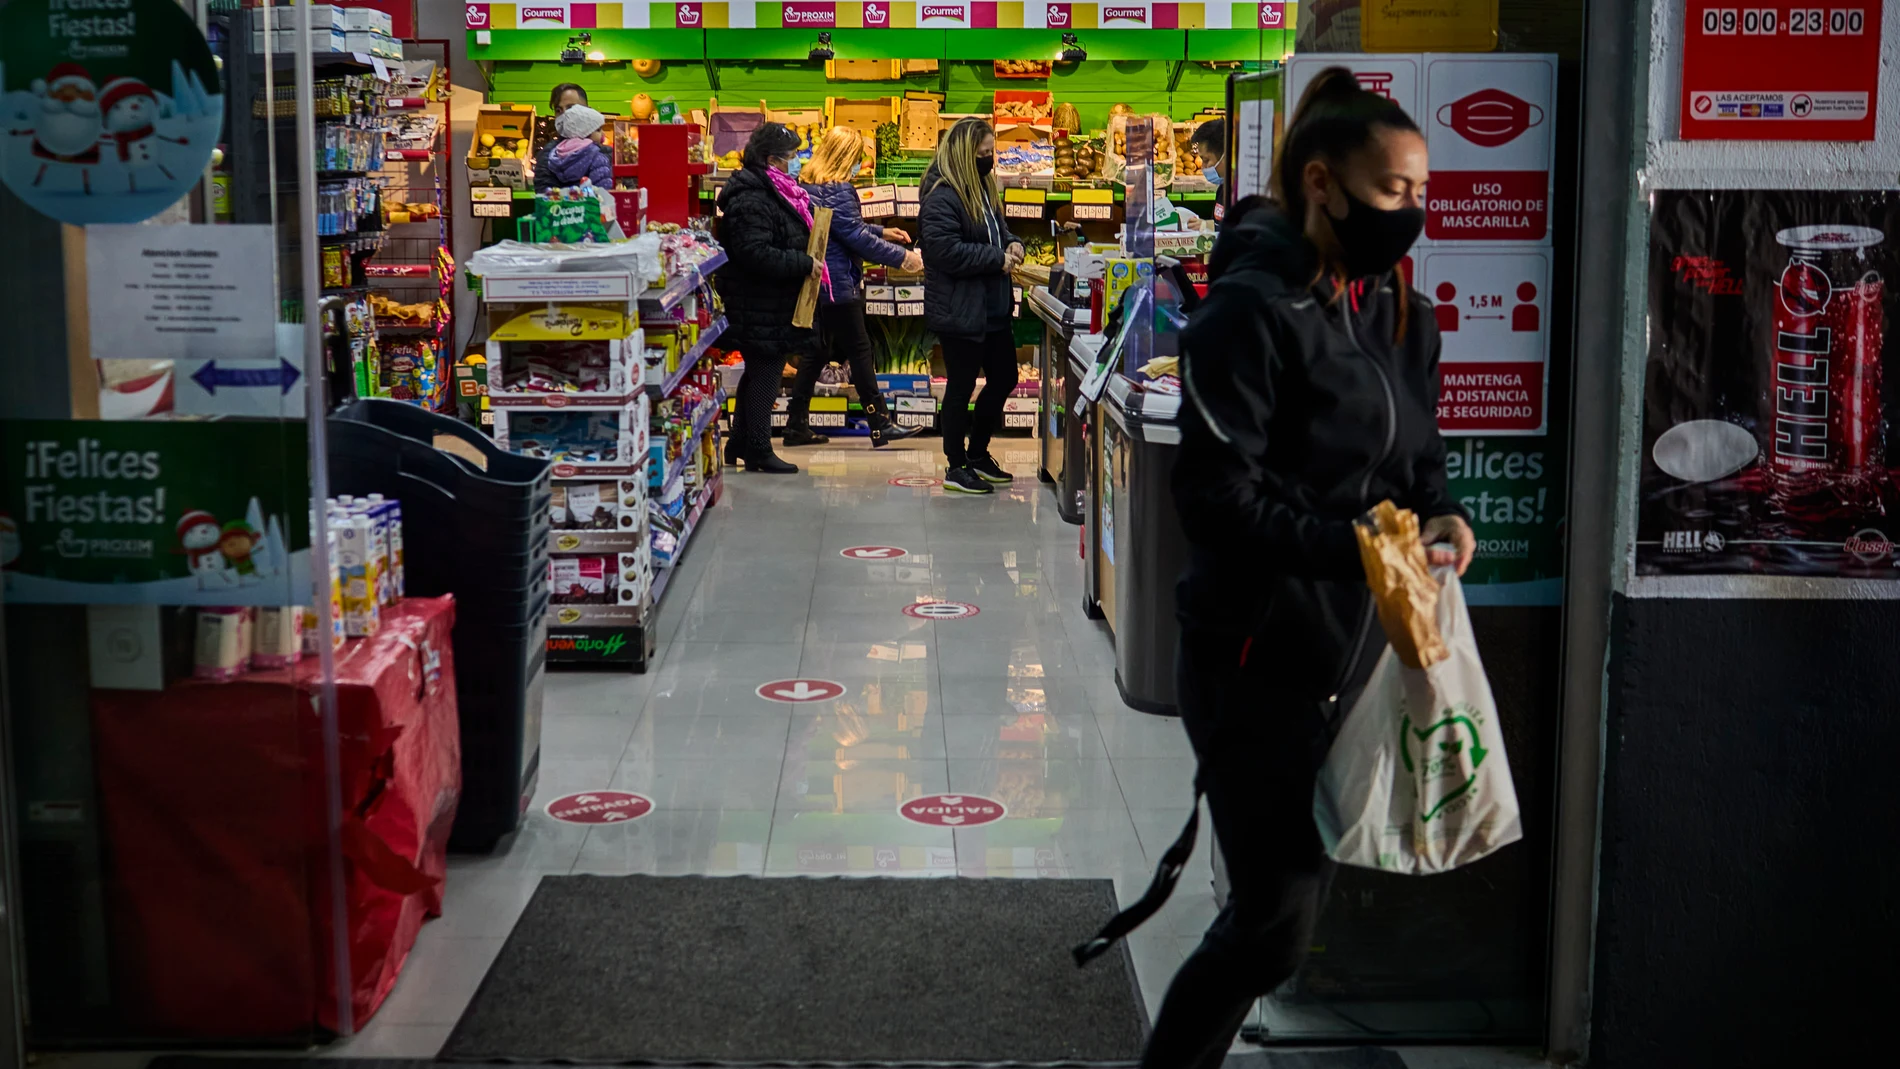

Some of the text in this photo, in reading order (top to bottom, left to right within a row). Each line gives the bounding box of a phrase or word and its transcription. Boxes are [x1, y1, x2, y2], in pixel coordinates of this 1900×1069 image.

[524, 8, 562, 18] Gourmet
[923, 6, 962, 16] Gourmet
[1105, 8, 1144, 18] Gourmet
[49, 13, 136, 38] Fiestas!
[1704, 11, 1863, 32] 09:00 a 23:00
[1716, 94, 1784, 102] LAS ACEPTAMOS
[1472, 183, 1502, 196] USO
[551, 205, 585, 217] Decora
[1429, 199, 1544, 212] OBLIGATORIO DE
[1442, 216, 1530, 228] MASCARILLA
[1469, 295, 1503, 309] 1,5 M
[1444, 374, 1522, 386] MANTENGA
[1456, 390, 1529, 402] DISTANCIA
[1775, 327, 1831, 459] HELL
[1453, 406, 1532, 418] SEGURIDAD
[25, 438, 160, 479] ¡Felices
[1446, 438, 1544, 480] elices
[25, 484, 166, 524] Fiestas!
[1459, 487, 1547, 525] stas!
[1663, 531, 1702, 548] HELL
[1844, 537, 1894, 553] Classic
[554, 797, 645, 818] ENTRADA
[910, 806, 996, 815] SALIDA
